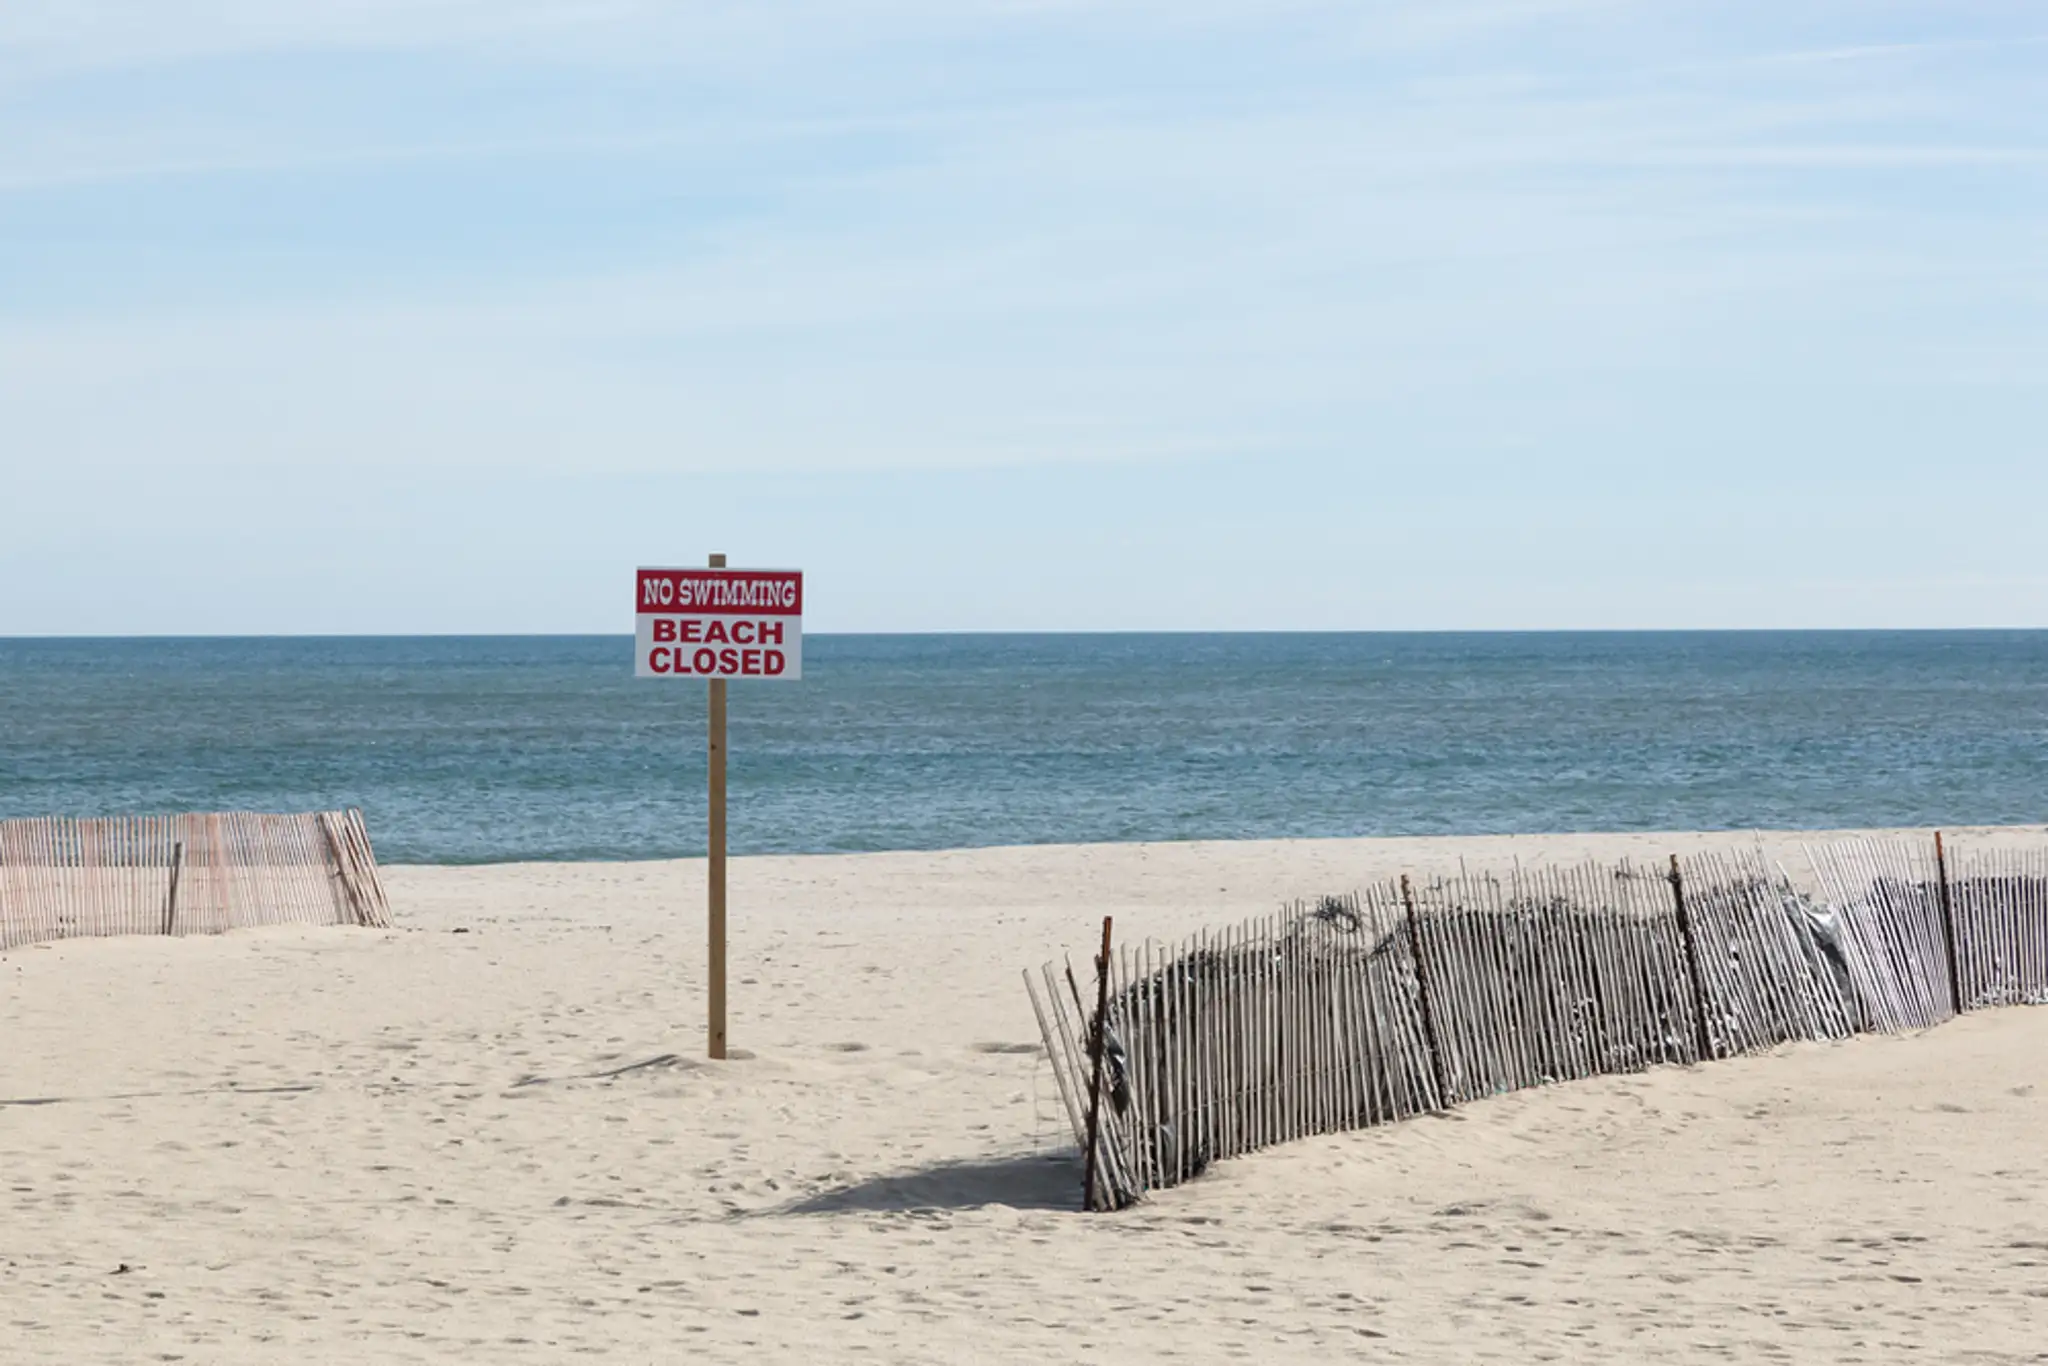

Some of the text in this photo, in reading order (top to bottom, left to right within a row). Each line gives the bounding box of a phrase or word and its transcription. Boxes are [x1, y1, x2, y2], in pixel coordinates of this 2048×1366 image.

[643, 578, 796, 608] NO SWIMMING
[653, 619, 783, 645] BEACH
[649, 647, 785, 675] CLOSED
